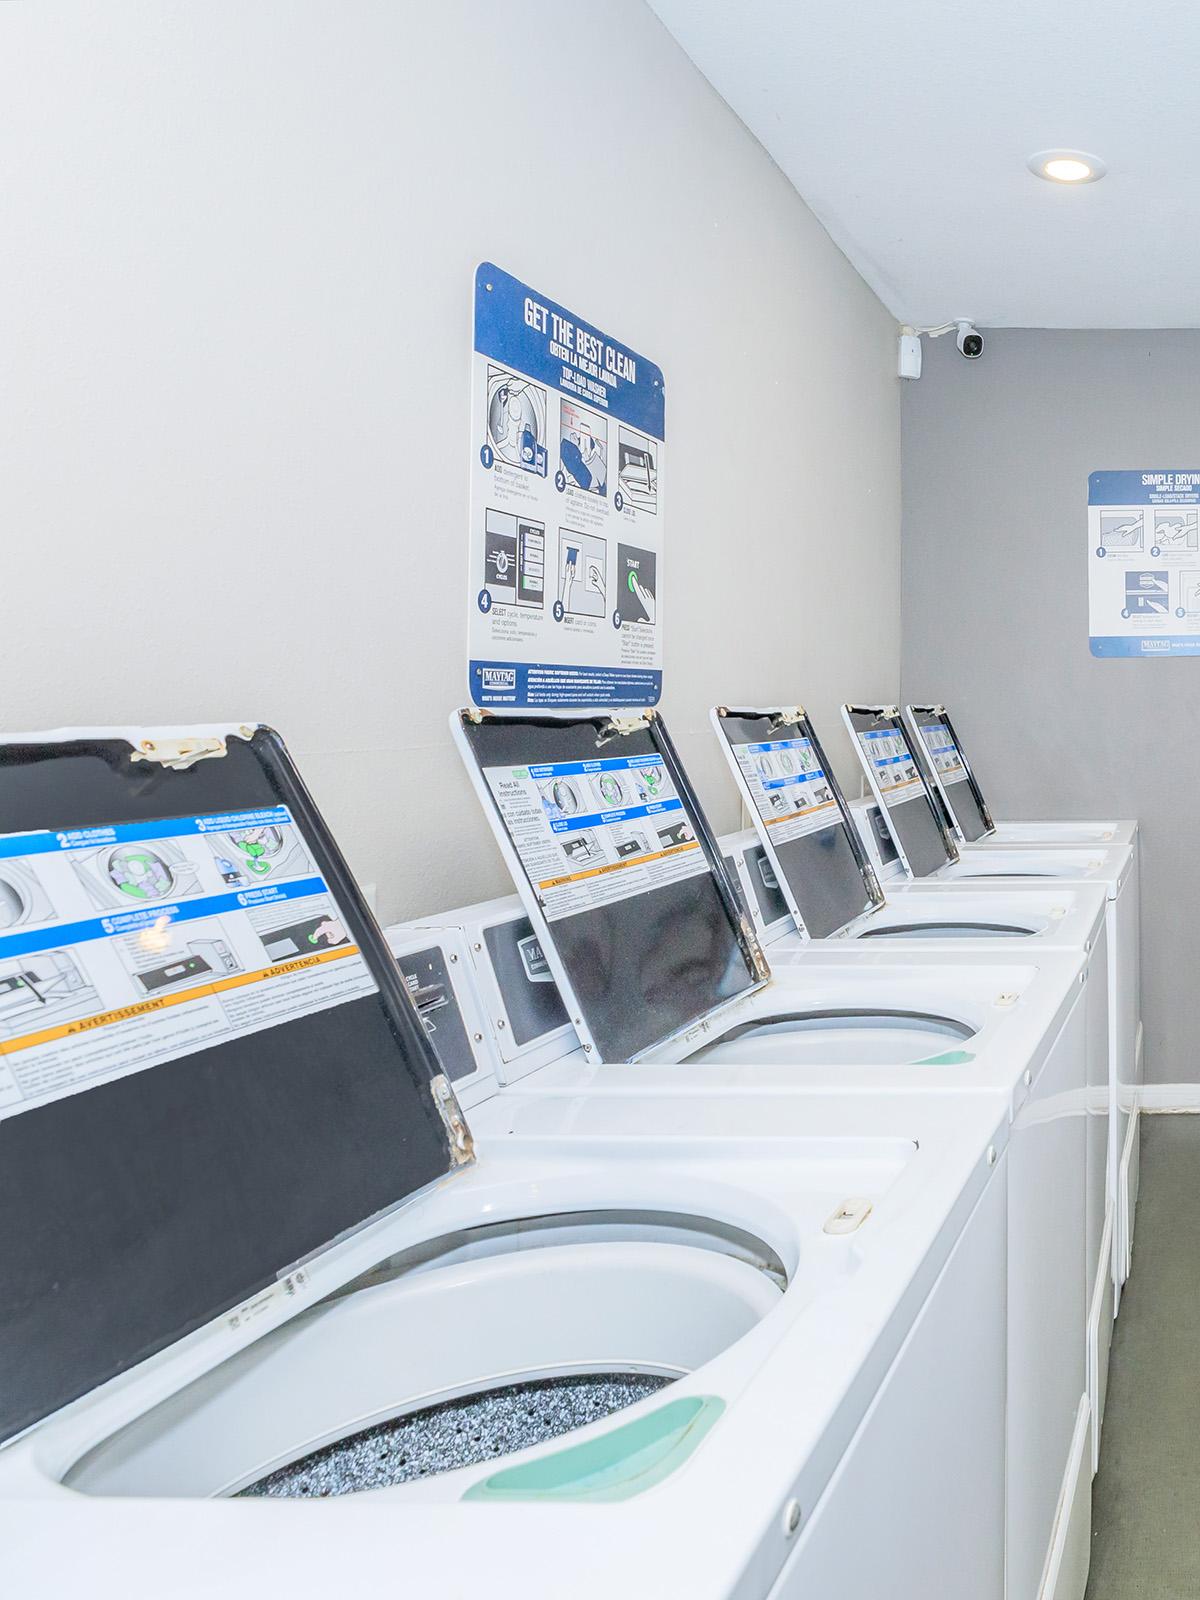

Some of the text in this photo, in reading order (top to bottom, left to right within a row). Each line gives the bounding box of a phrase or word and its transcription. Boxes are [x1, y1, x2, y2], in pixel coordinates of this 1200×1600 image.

[524, 298, 636, 384] GET THE BEST CLEAN
[483, 448, 490, 464] 1
[557, 475, 564, 488] 2
[1142, 474, 1174, 485] SIMPLE
[616, 496, 621, 507] 3
[480, 593, 488, 609] 4
[492, 607, 507, 616] SELECT
[556, 603, 562, 617] 5
[615, 612, 620, 625] 6
[485, 671, 514, 682] MAYTAG
[499, 781, 513, 789] Read
[195, 819, 206, 832] 3
[56, 832, 71, 848] 2
[237, 893, 248, 906] 6
[101, 918, 115, 934] 5
[271, 956, 321, 974] ADVERTENCIA
[79, 998, 165, 1030] AVERTISSEMENT
